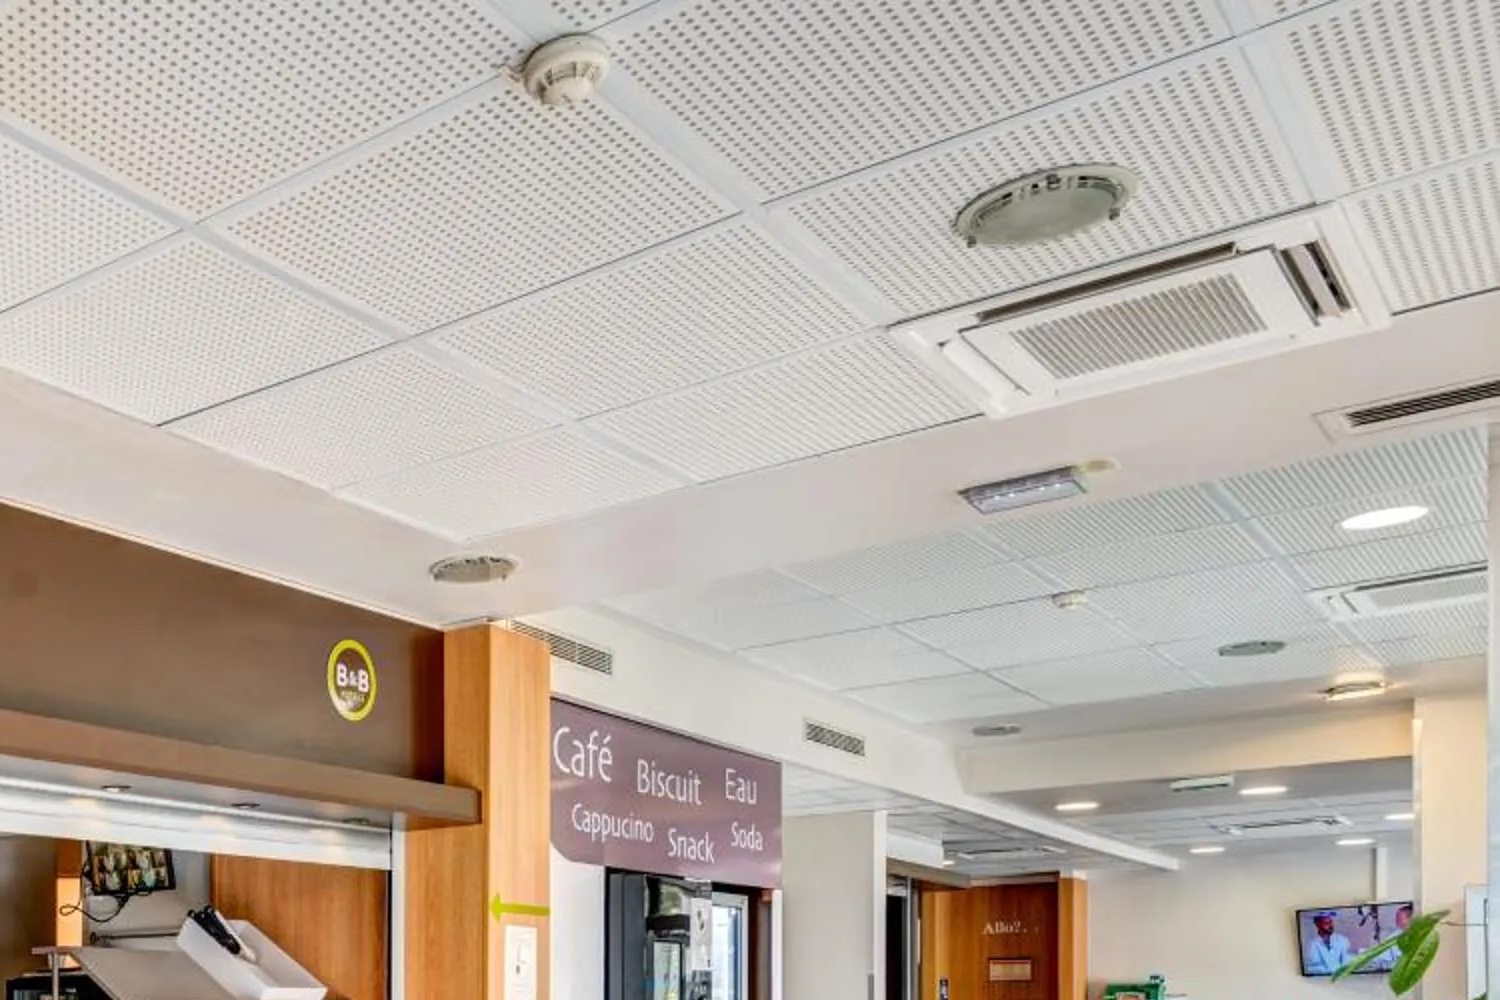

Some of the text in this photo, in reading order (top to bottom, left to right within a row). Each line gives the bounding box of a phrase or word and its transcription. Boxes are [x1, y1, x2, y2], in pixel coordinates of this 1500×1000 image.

[337, 661, 369, 693] B&B
[553, 726, 758, 805] Café Biscuit Eau
[571, 803, 763, 864] Cappucino Snack Soda
